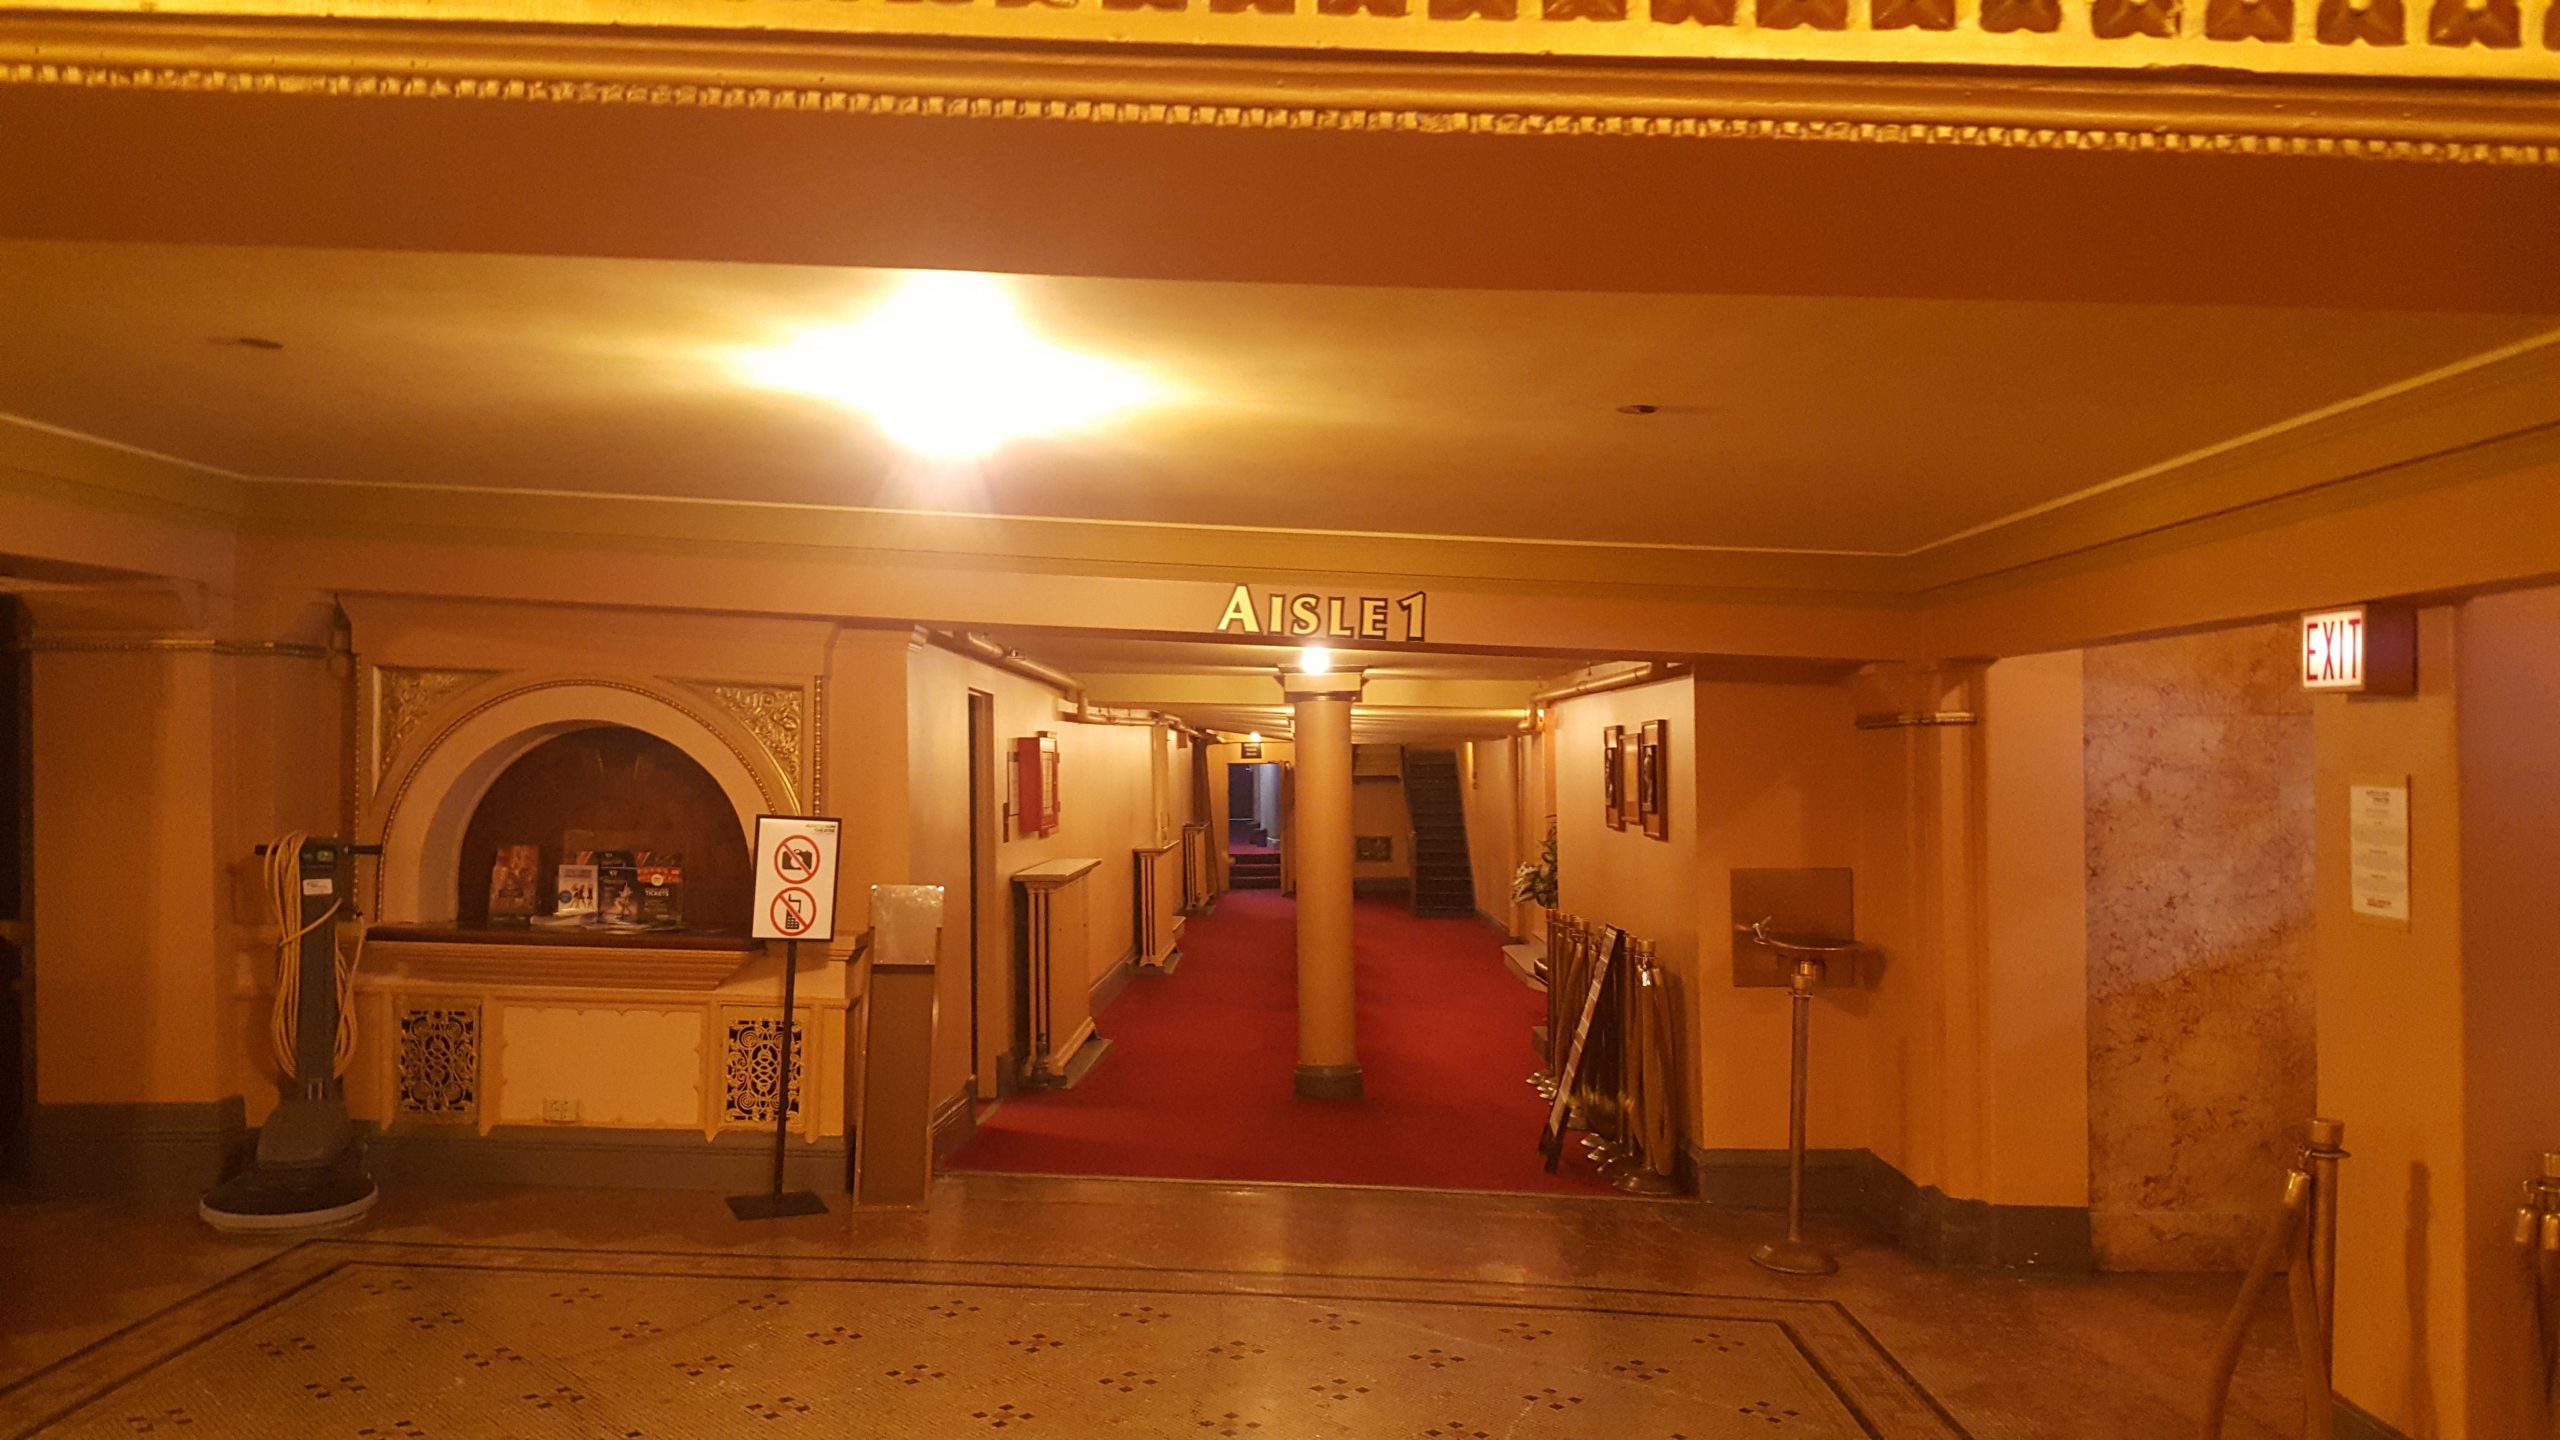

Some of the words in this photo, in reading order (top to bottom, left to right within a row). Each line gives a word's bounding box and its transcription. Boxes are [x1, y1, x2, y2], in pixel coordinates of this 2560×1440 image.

[1216, 583, 1388, 640] AISLE
[1396, 590, 1427, 642] 1
[2306, 618, 2361, 681] EXIT
